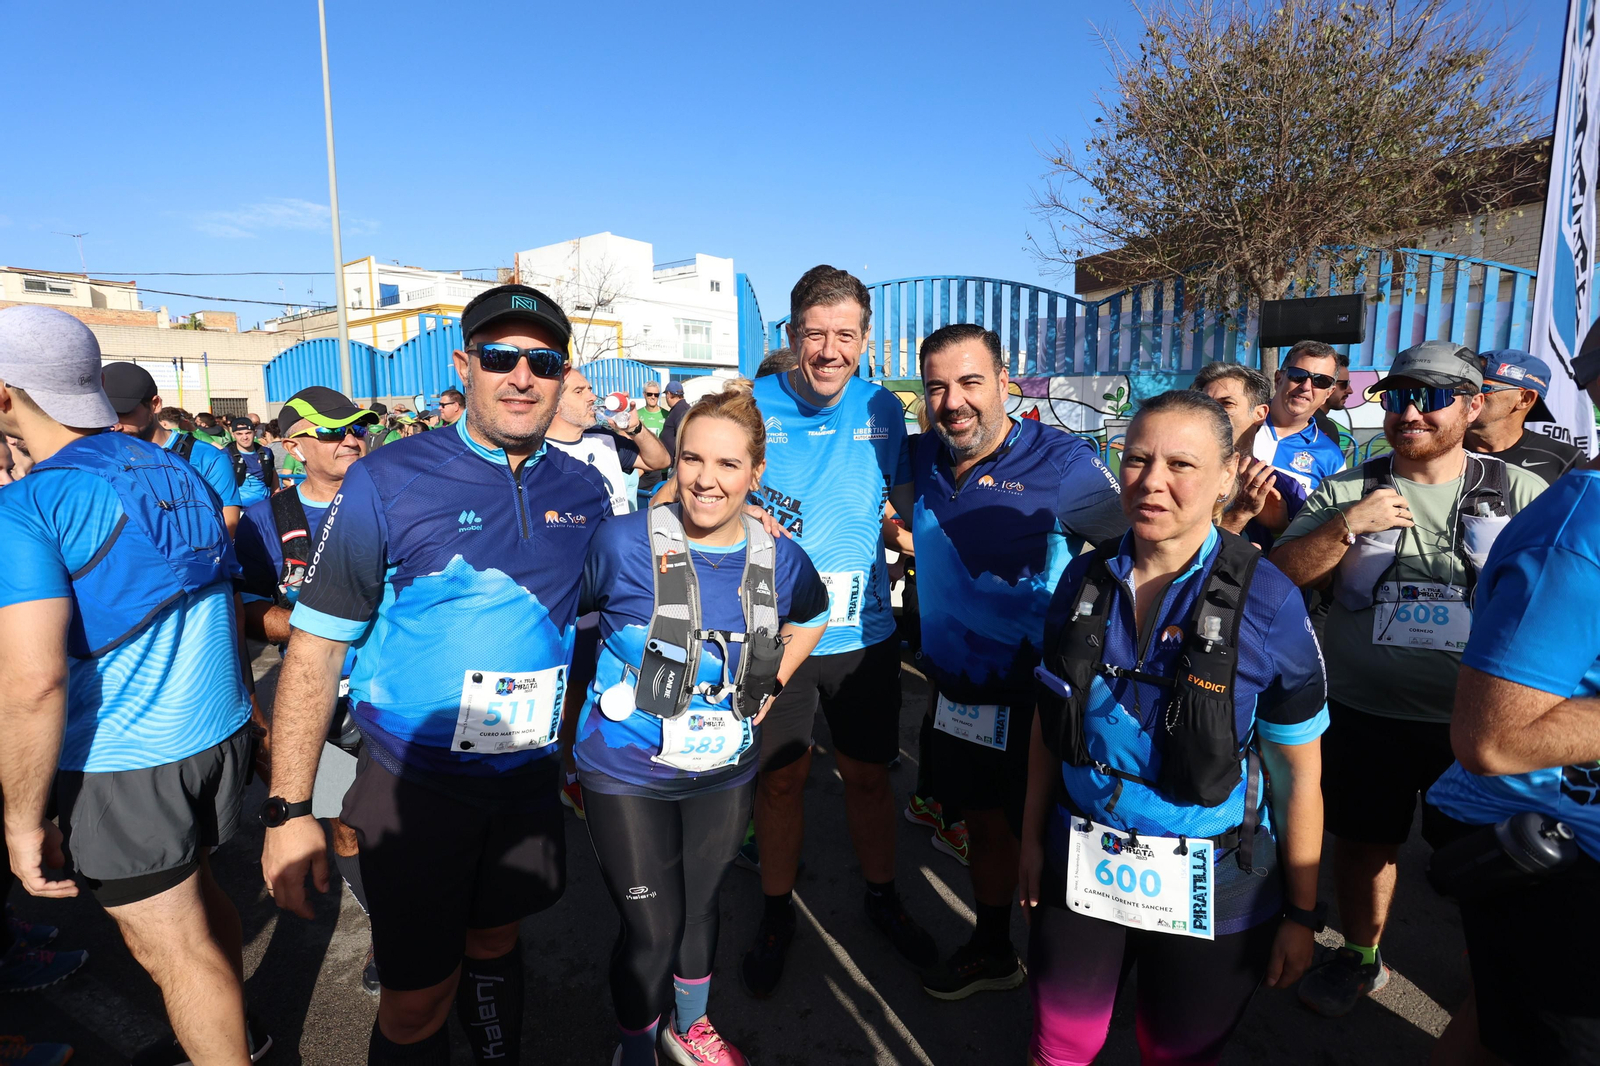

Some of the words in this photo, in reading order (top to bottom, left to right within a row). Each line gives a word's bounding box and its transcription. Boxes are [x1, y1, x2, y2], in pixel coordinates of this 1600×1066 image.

[1395, 603, 1450, 626] 608
[1187, 673, 1227, 693] EVADICT
[482, 698, 536, 726] 511
[680, 735, 726, 754] 583
[1121, 845, 1155, 859] PIRATA
[1094, 859, 1162, 897] 600
[1192, 848, 1208, 931] PIRATILLA
[1083, 887, 1111, 899] CARMEN
[1111, 894, 1140, 908] LORENTE
[1141, 903, 1174, 913] SANCHEZ
